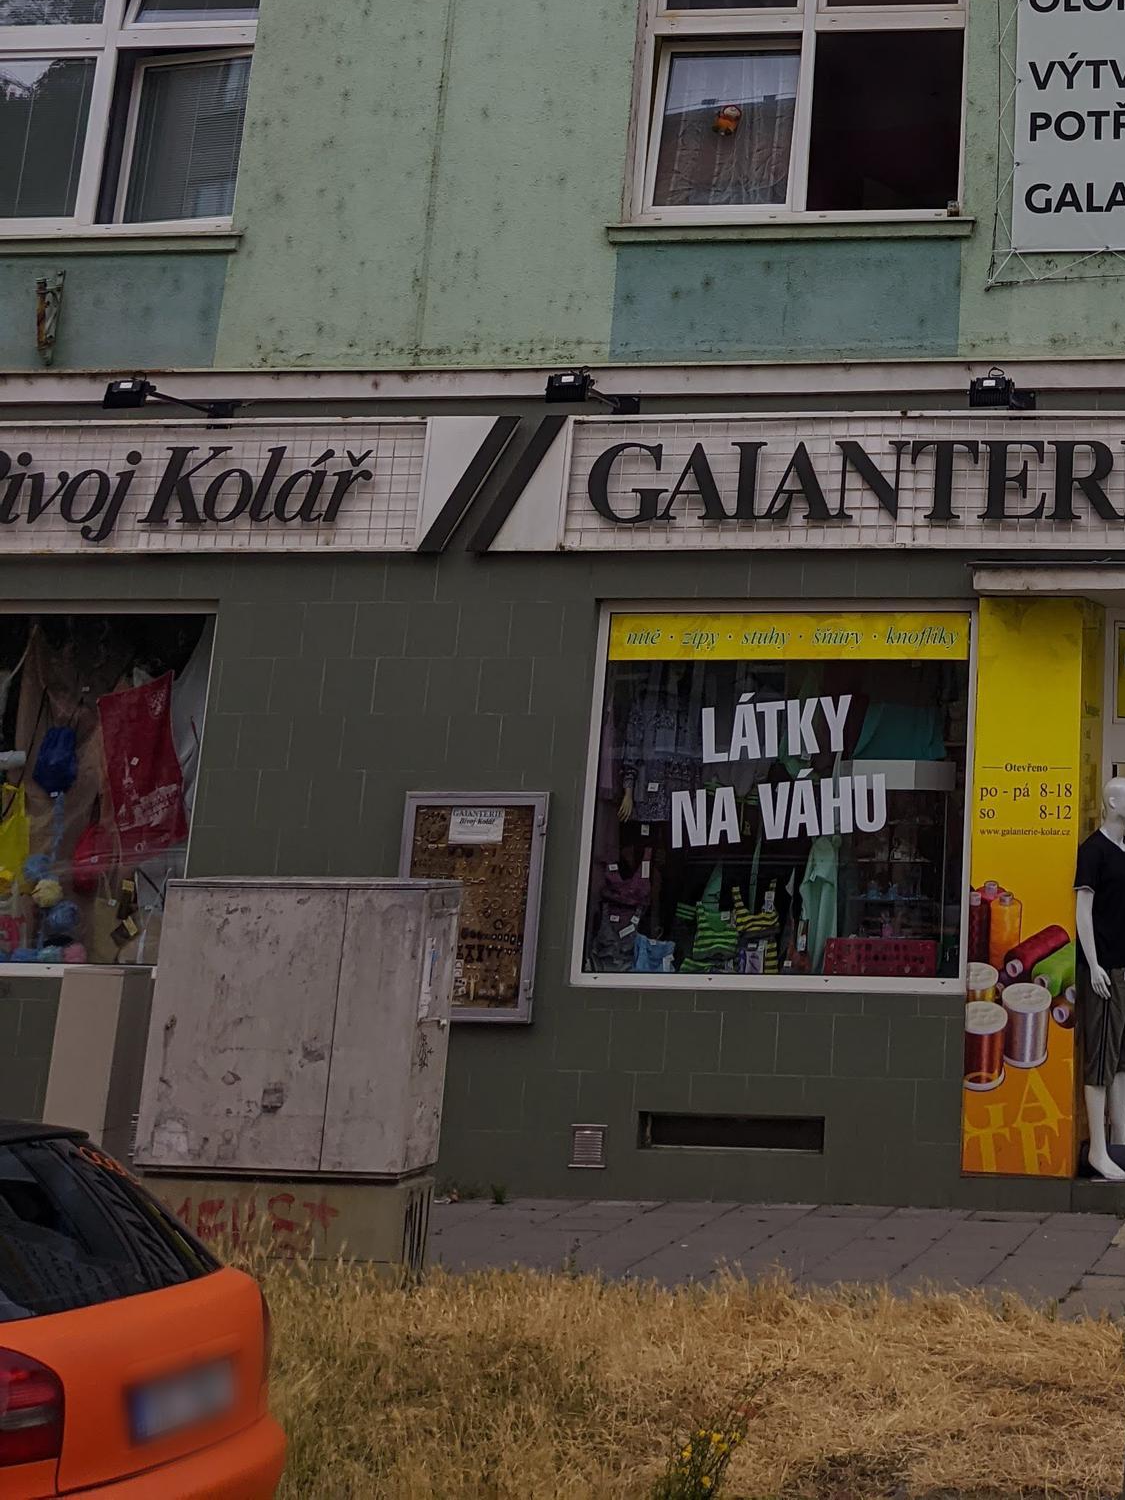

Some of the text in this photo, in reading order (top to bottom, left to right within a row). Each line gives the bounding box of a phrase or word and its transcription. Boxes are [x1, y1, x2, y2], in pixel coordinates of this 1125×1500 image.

[138, 445, 374, 527] Kolář
[626, 629, 661, 646] nitě
[682, 631, 720, 650] zipy
[741, 628, 791, 650] stuhy
[701, 692, 853, 764] LÁTKY
[1004, 763, 1049, 773] Otevřeno
[980, 786, 998, 801] po
[1013, 782, 1030, 801] pá
[1040, 783, 1073, 798] 8-18
[671, 768, 888, 849] NA VÁHU
[979, 804, 1072, 820] so 8-12
